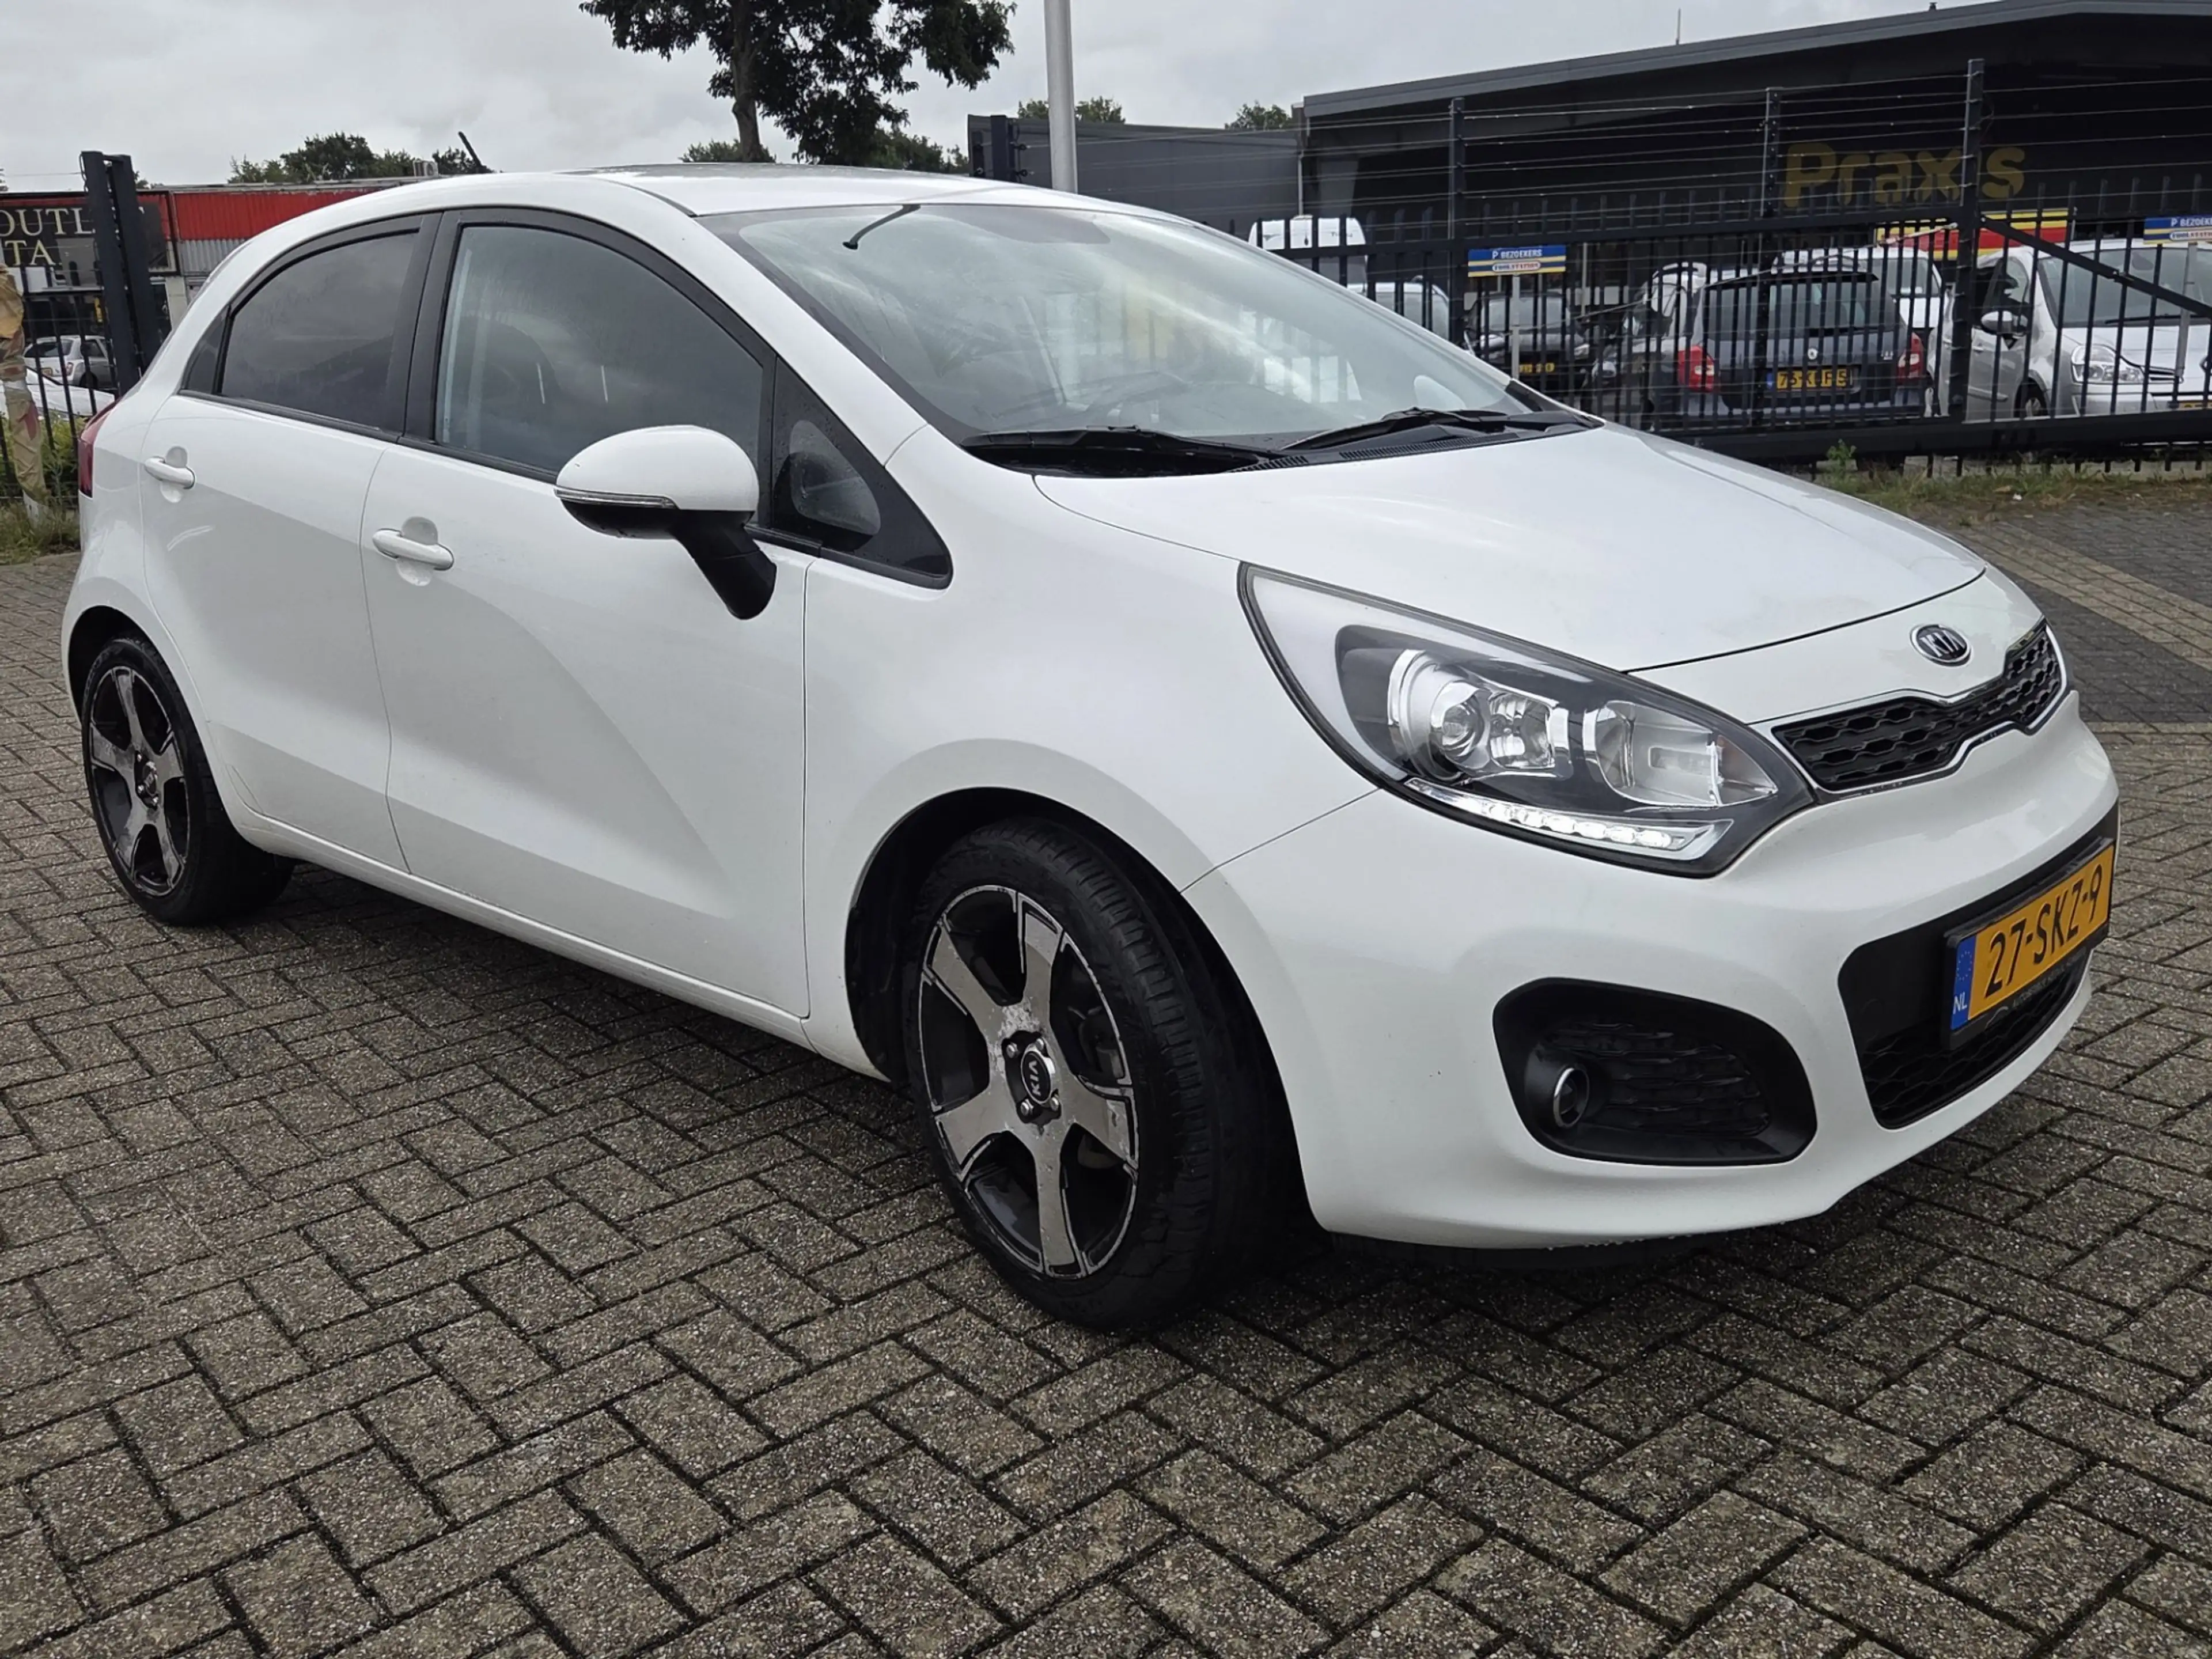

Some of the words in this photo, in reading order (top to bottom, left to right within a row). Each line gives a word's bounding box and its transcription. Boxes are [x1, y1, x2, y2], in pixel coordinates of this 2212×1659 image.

[1783, 142, 2026, 209] Praxs
[5, 239, 62, 266] TA
[1919, 630, 1965, 657] KIA
[1984, 863, 2103, 999] 27-SKZ-9
[1952, 991, 1968, 1015] NL
[1028, 1060, 1041, 1097] KIA
